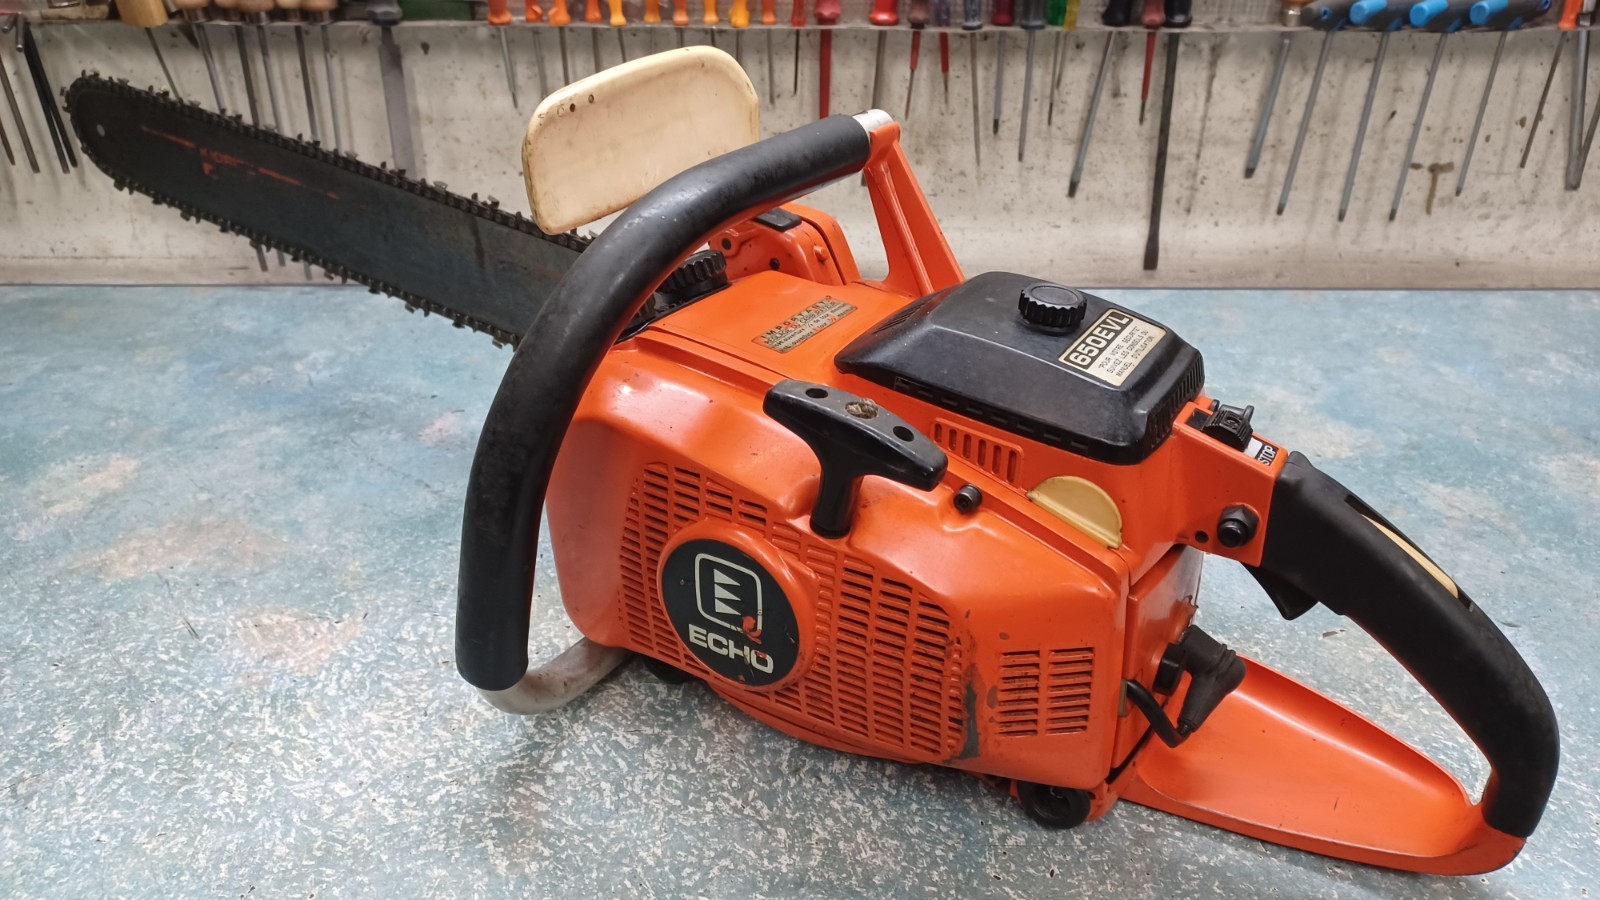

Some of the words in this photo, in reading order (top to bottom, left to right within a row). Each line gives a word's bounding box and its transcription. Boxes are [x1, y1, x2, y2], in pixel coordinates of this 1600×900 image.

[1068, 315, 1130, 366] 650EVL
[1258, 445, 1276, 466] STOP
[689, 623, 774, 674] ECHO
